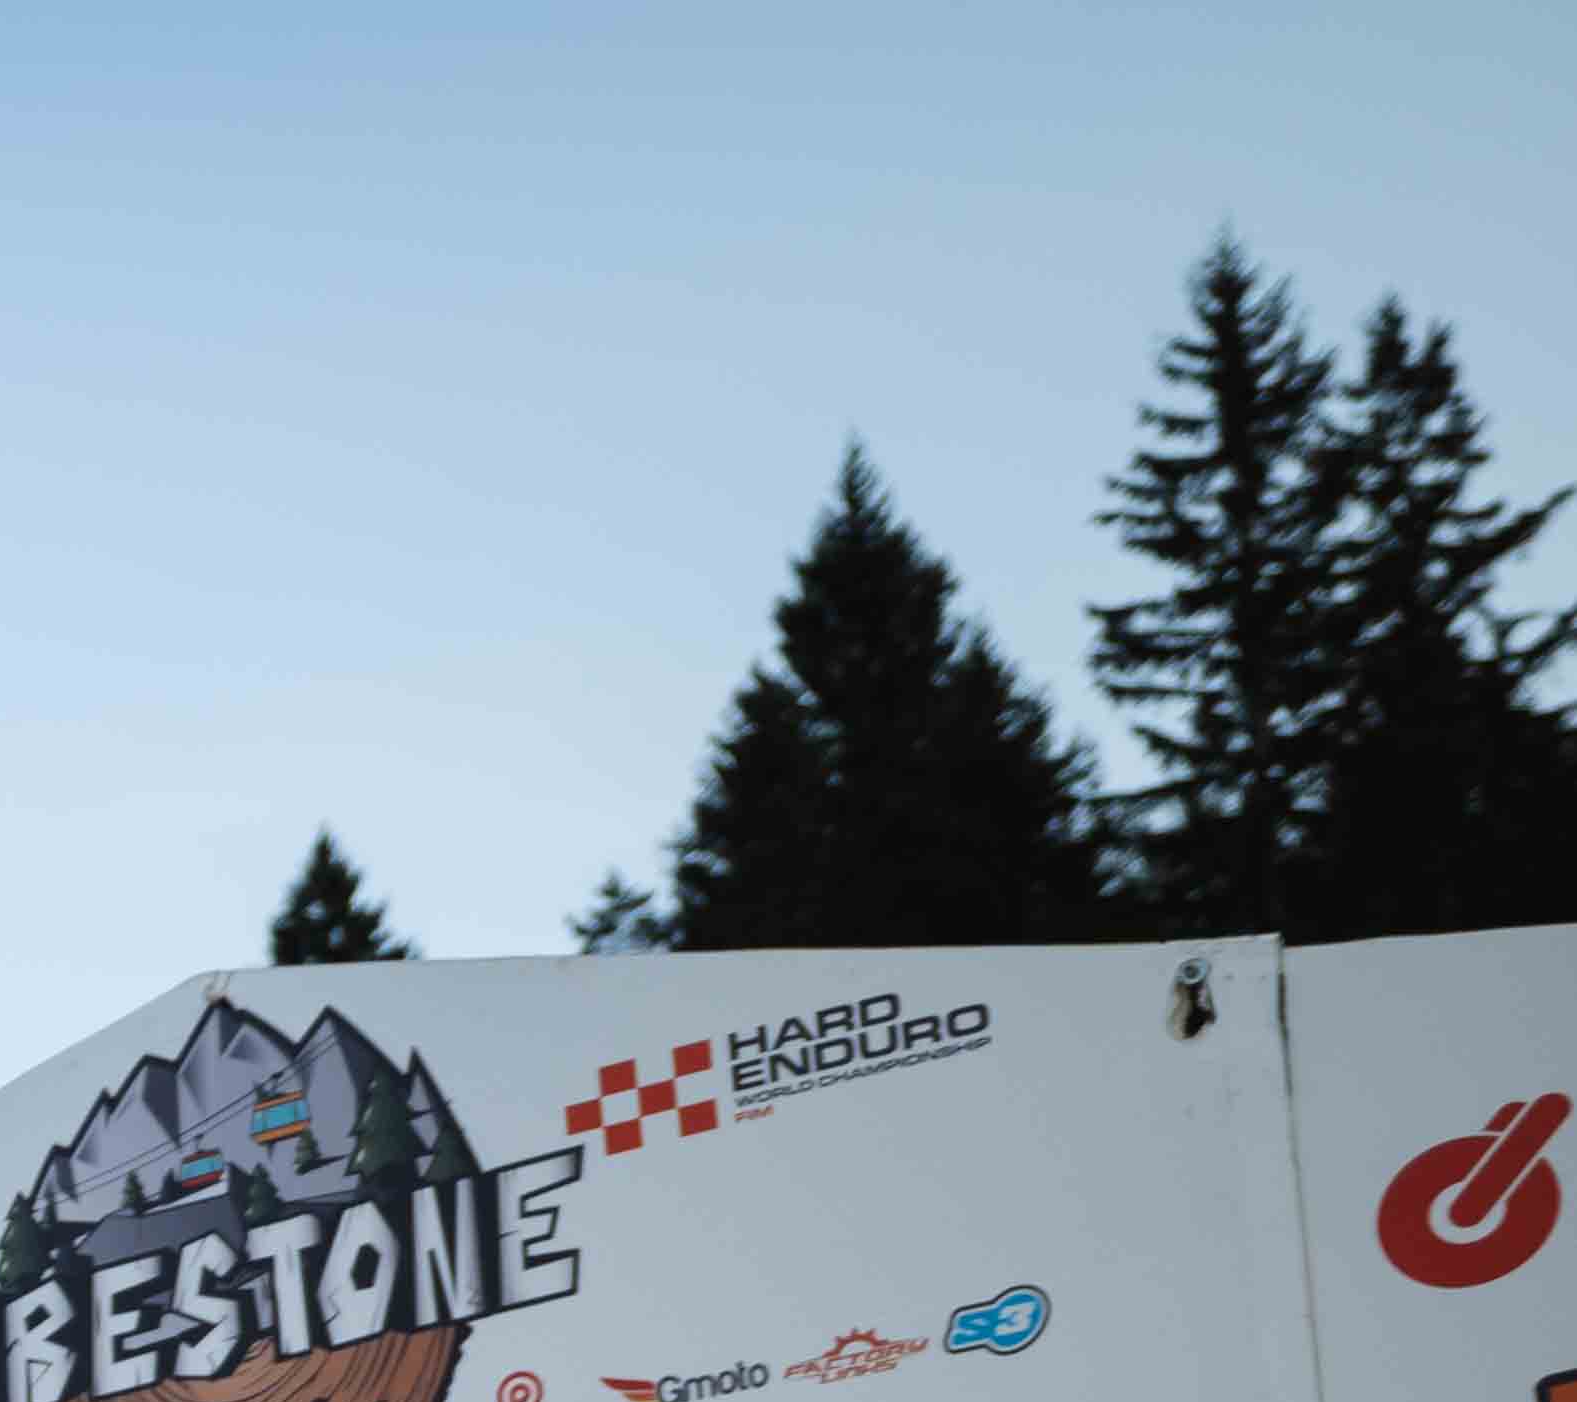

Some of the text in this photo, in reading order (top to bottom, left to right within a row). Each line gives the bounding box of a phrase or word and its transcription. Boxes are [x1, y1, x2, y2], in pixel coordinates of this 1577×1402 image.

[728, 992, 901, 1061] HARD
[730, 1002, 990, 1094] ENDURO
[735, 1036, 993, 1109] WORLD CHAMPIONSHIP
[950, 1292, 1039, 1351] S3
[783, 1337, 930, 1381] FACTORY
